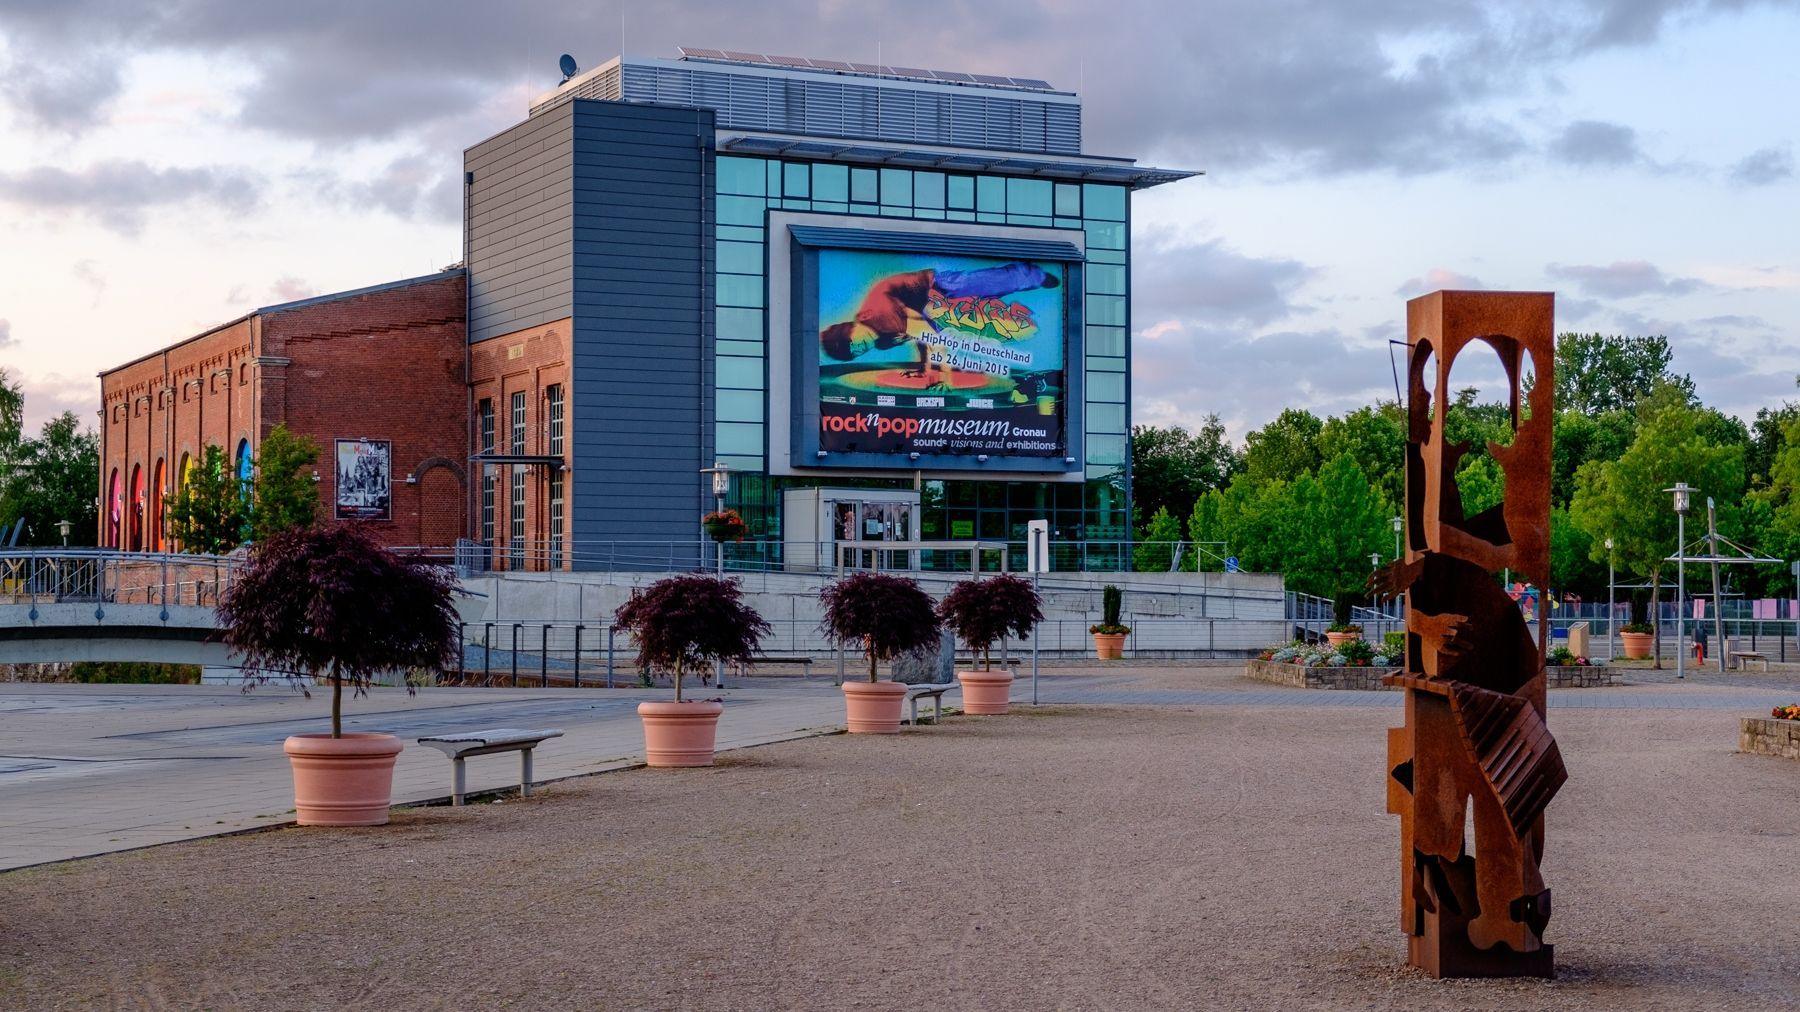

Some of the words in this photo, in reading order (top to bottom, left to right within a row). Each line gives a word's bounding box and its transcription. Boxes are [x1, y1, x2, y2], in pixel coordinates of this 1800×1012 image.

[921, 331, 959, 350] HipHop
[961, 340, 970, 350] in
[972, 342, 1031, 363] Deutschland
[930, 352, 943, 362] ab
[946, 353, 961, 366] 26.
[962, 357, 982, 370] Juni
[985, 362, 1008, 376] 2015
[1012, 427, 1047, 437] Gronau
[985, 438, 1005, 449] and
[1006, 440, 1056, 450] exhibitions
